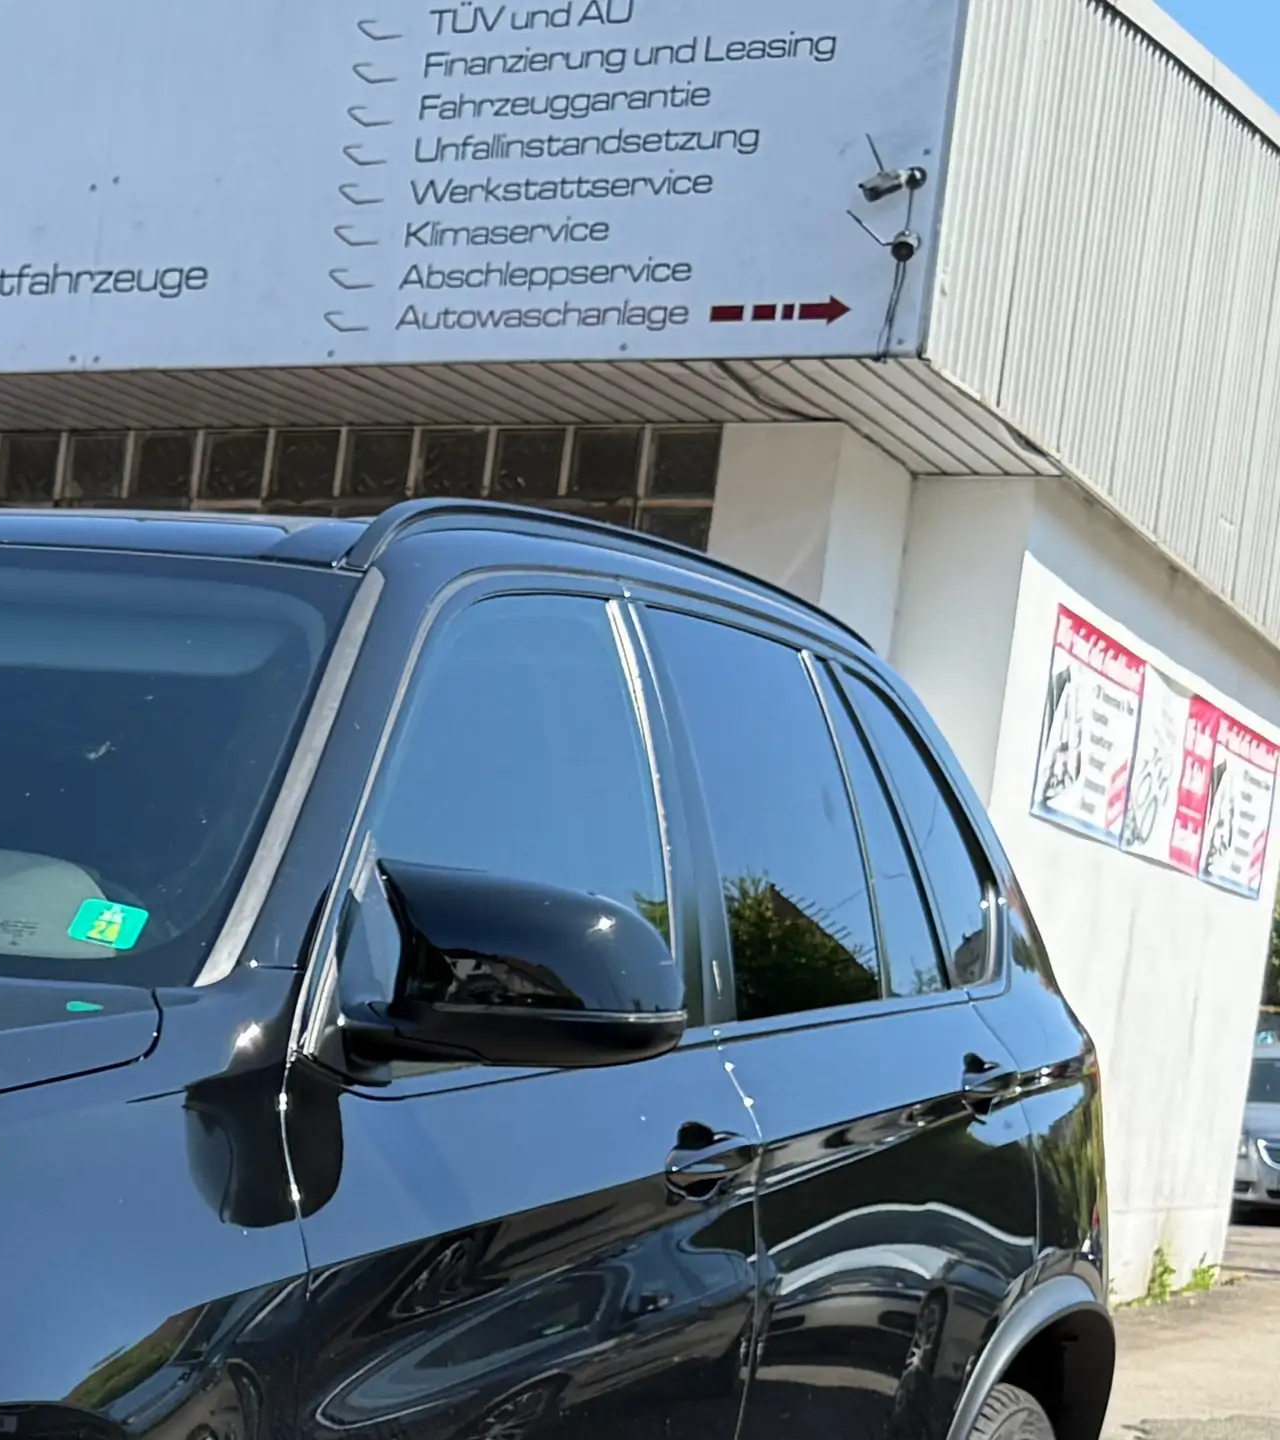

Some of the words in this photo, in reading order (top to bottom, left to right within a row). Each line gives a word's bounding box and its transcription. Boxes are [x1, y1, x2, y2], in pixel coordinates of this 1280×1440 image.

[429, 1, 506, 36] TÜV
[510, 1, 572, 31] und
[576, 0, 635, 27] AU
[423, 47, 627, 79] Finanzierung
[633, 36, 697, 67] und
[704, 30, 837, 63] Leasing
[418, 80, 712, 120] Fahrzeuggarantie
[414, 127, 761, 164] Unfallinstandsetzung
[409, 172, 714, 206] Werkstattservice
[404, 218, 610, 249] Klimaservice
[398, 258, 693, 292] Abschleppservice
[394, 301, 690, 332] Autowaschanlage
